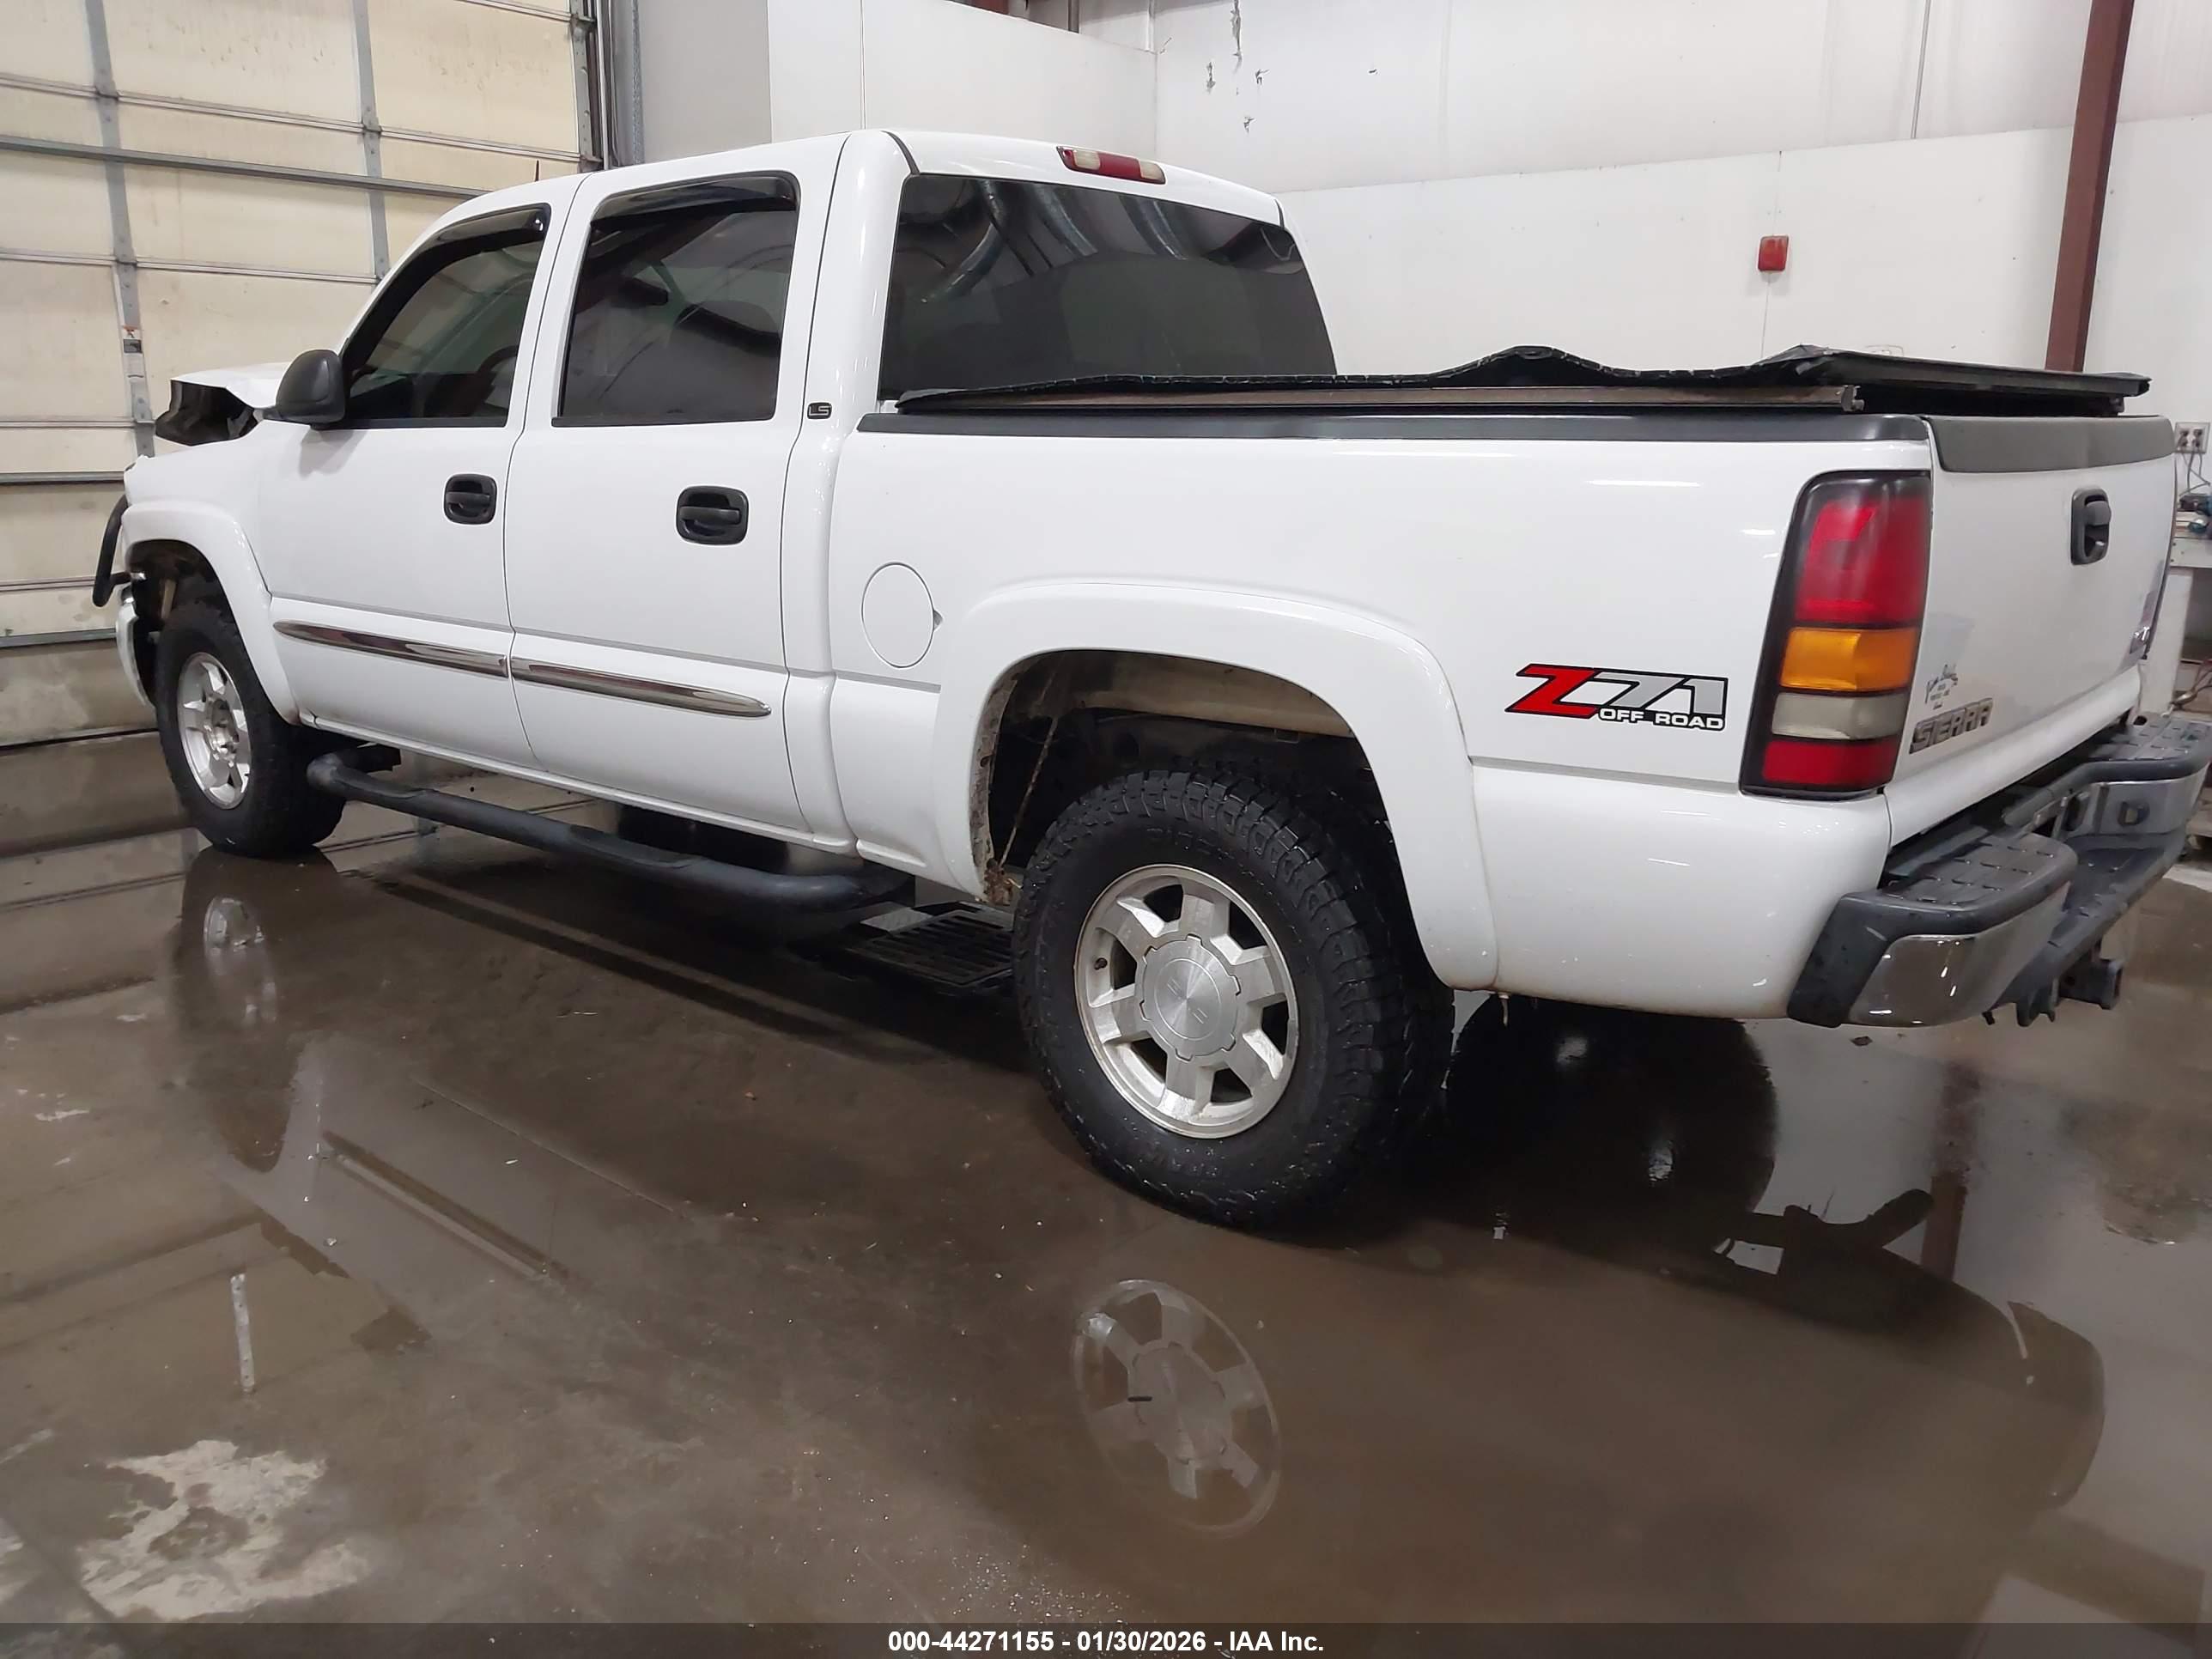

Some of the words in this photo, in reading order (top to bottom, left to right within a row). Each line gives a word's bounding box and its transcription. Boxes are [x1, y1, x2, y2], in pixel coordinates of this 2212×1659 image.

[809, 405, 832, 416] LS
[1504, 663, 1728, 720] Z71
[1600, 708, 1644, 722] OFF
[1655, 713, 1724, 729] ROAD
[1909, 697, 1993, 755] SIERRA
